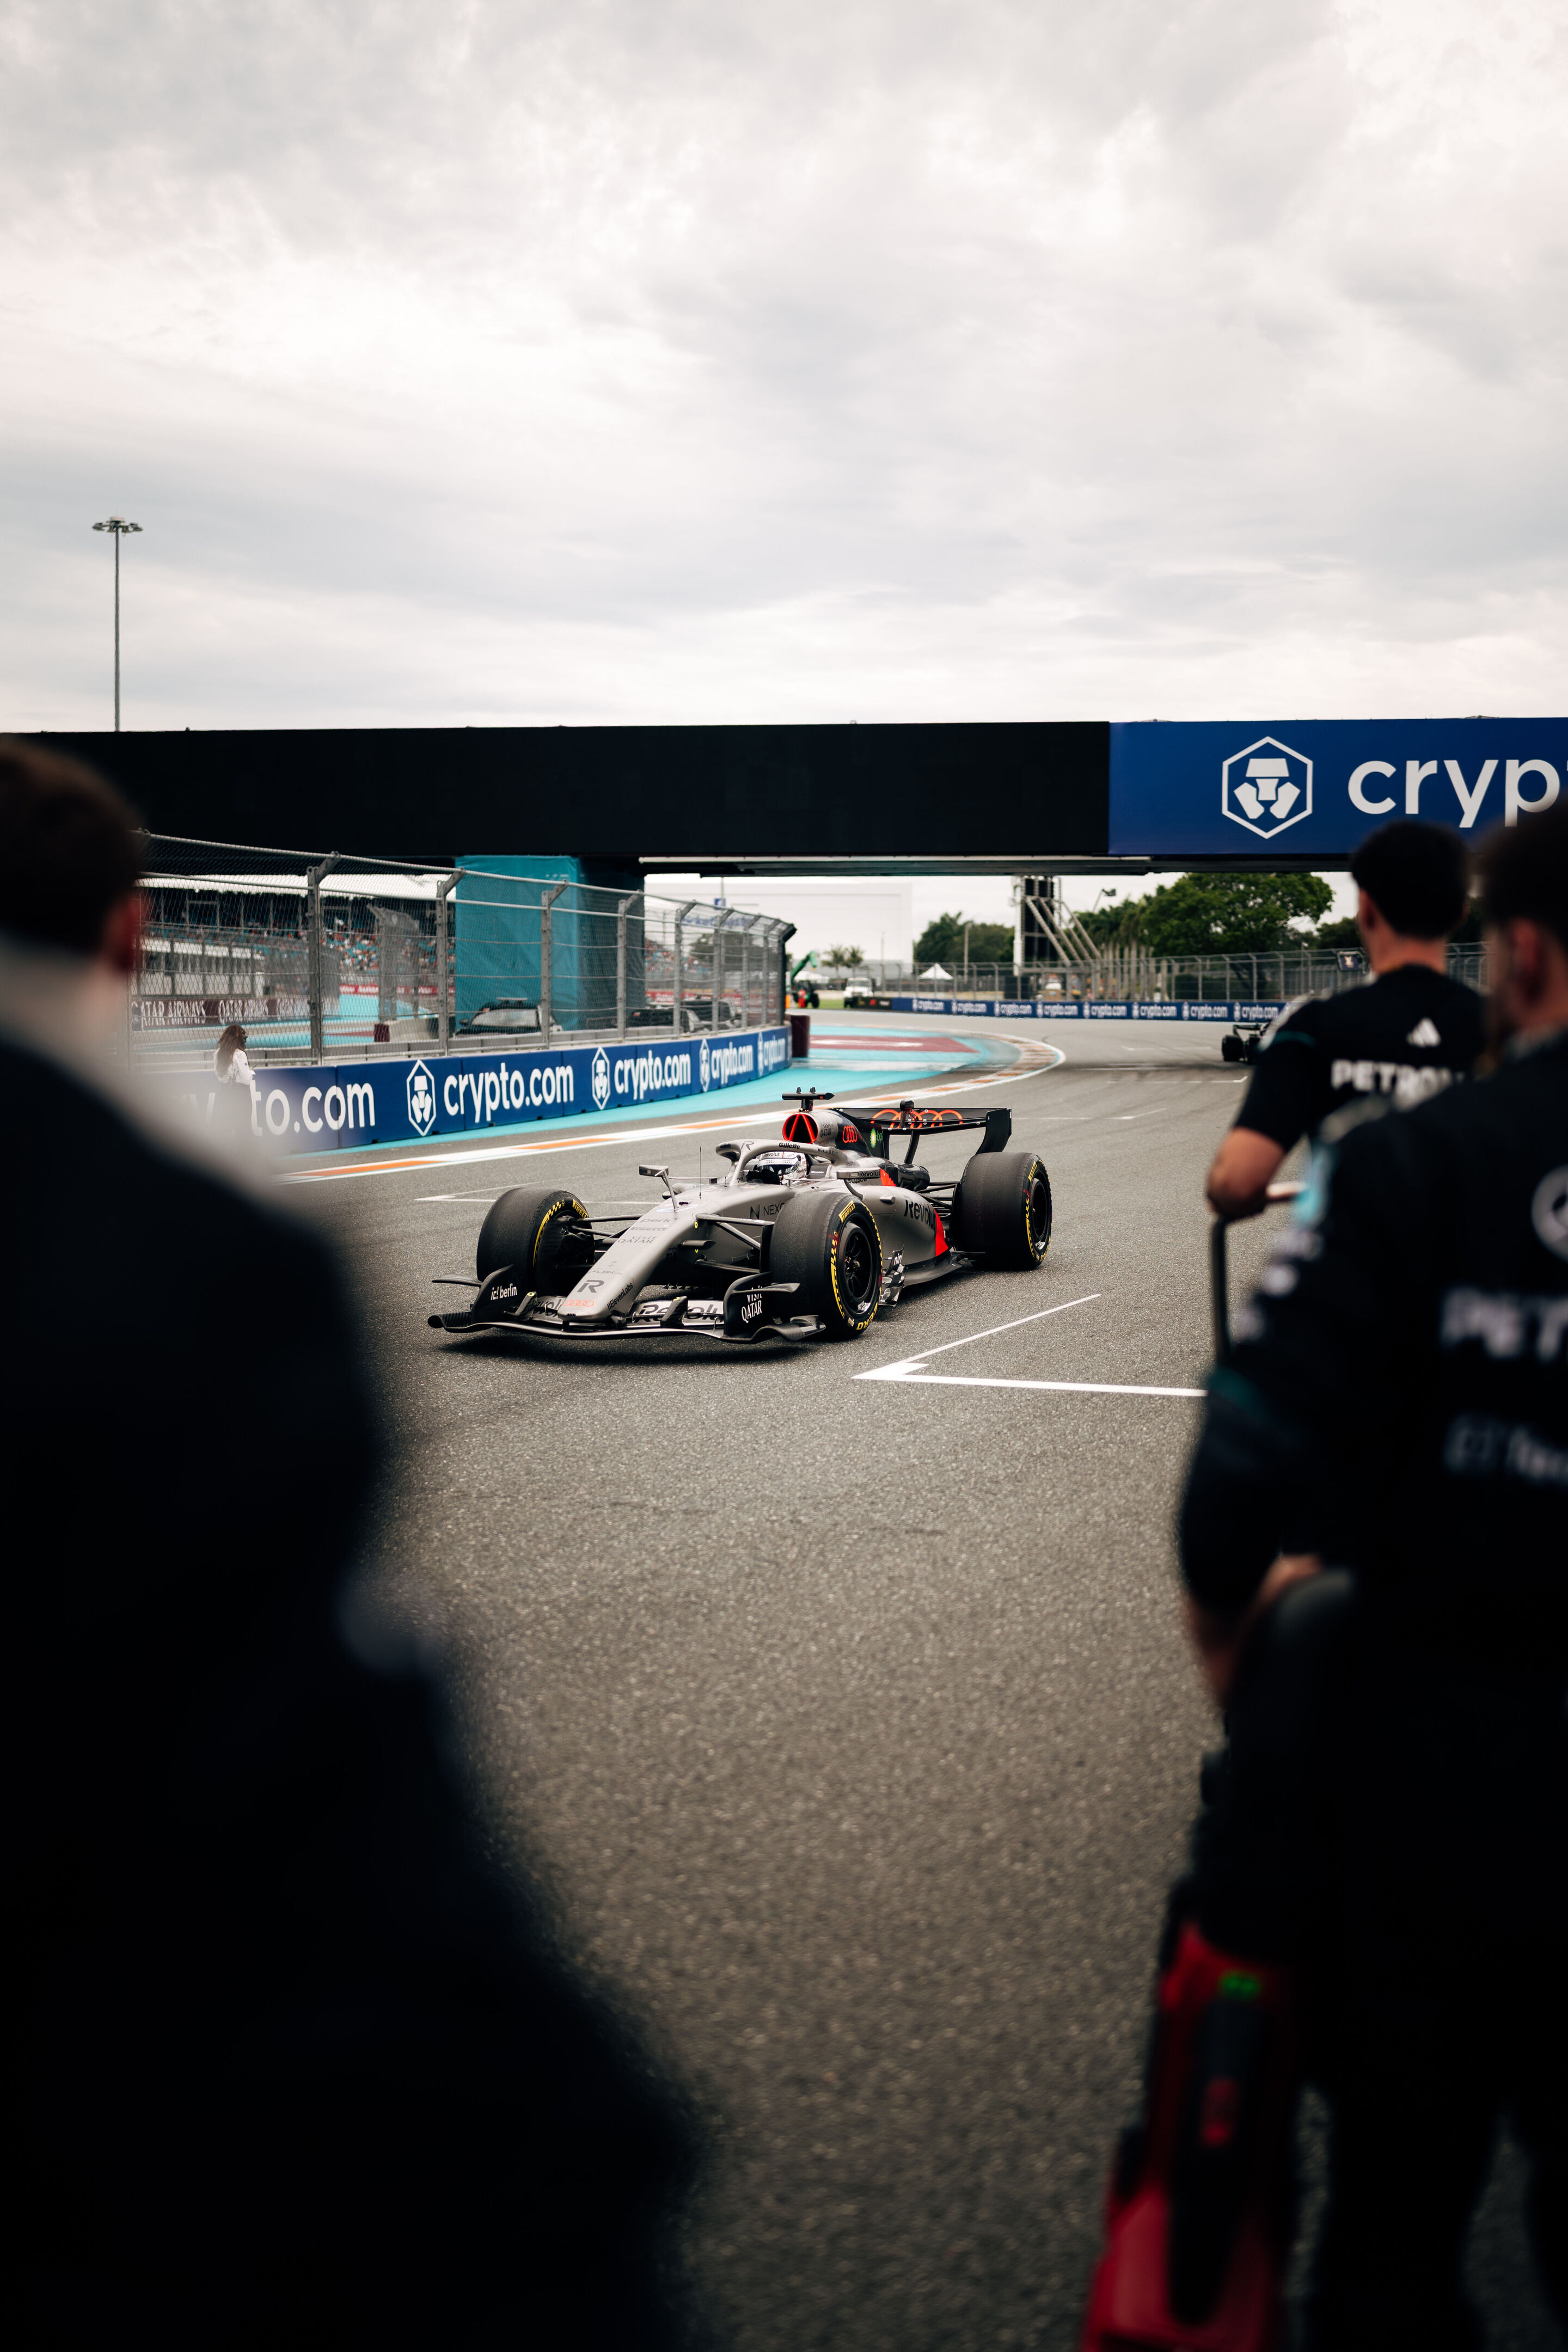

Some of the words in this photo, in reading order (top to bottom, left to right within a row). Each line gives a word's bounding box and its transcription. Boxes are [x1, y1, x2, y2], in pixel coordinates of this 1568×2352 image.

[1348, 759, 1568, 828] cryp
[1091, 1004, 1127, 1018] crypto.com
[1140, 1004, 1177, 1018] crypto.com
[1191, 1004, 1228, 1020] crypto.com
[1242, 1004, 1278, 1020] crypto.com
[712, 1041, 753, 1085] crypto.com
[614, 1050, 691, 1100] crypto.com
[444, 1062, 574, 1123] crypto.com
[877, 1130, 882, 1144] bp
[838, 1200, 855, 1223] PIRELLI
[499, 1283, 517, 1298] berlin
[742, 1300, 762, 1324] QATAR
